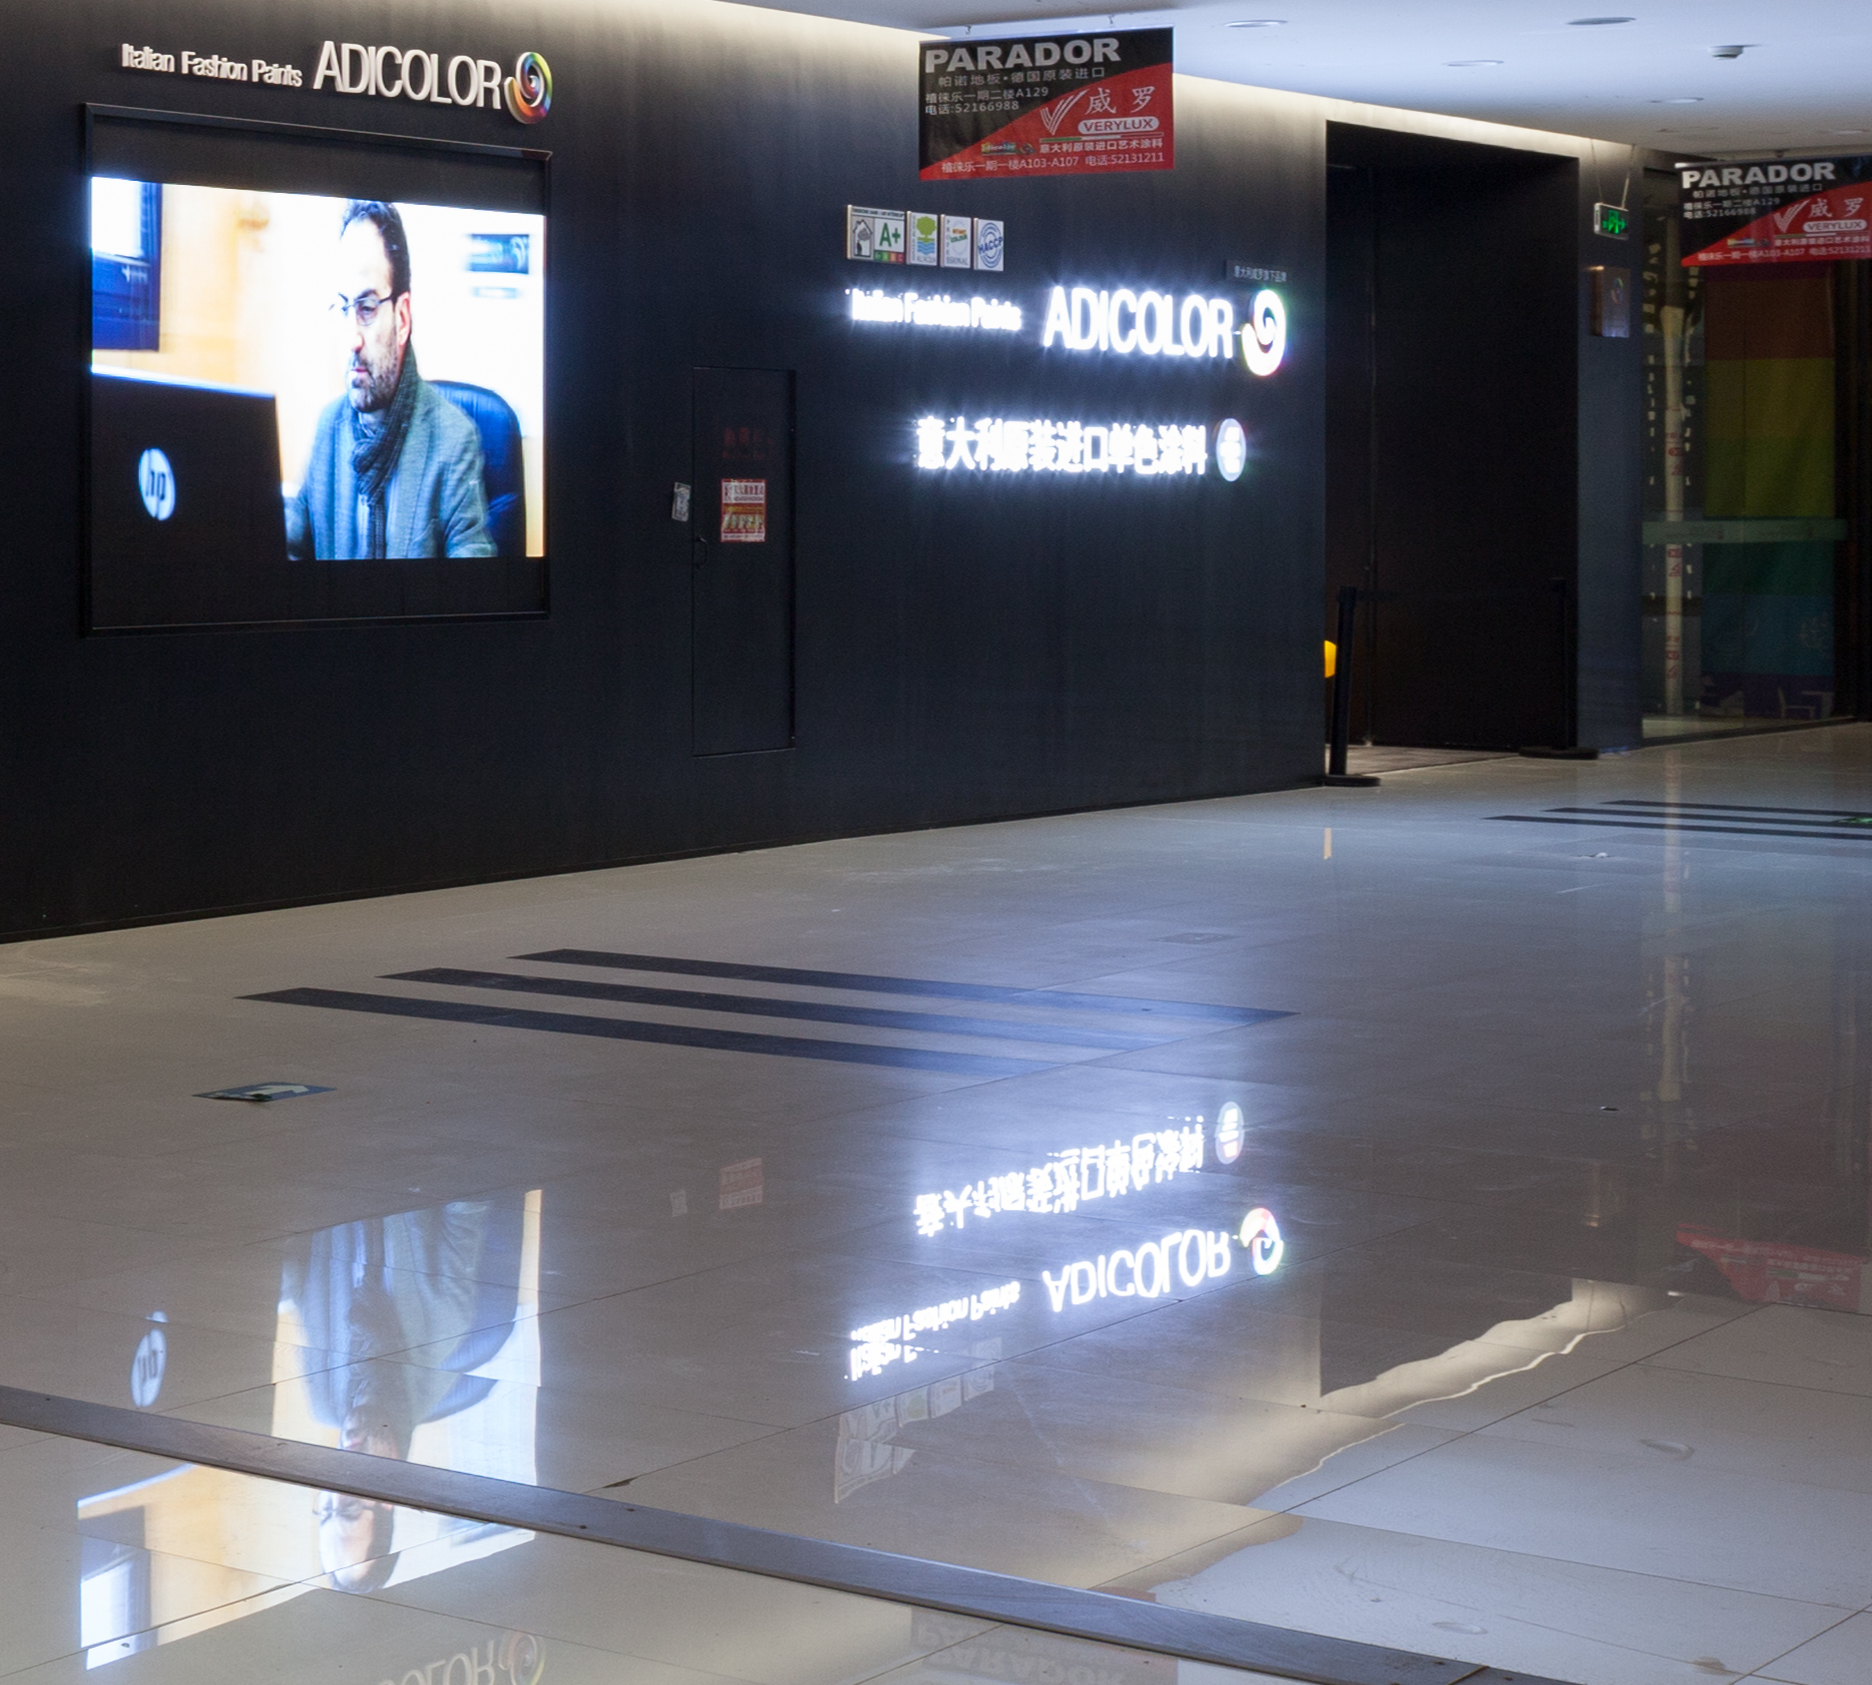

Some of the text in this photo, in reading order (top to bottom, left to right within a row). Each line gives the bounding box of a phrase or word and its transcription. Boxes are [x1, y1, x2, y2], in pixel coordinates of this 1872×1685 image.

[924, 37, 1122, 74] PARADOR
[122, 40, 502, 110] Italian Fashion Paints ADICOLOR
[1084, 86, 1155, 115] 威罗
[1083, 118, 1154, 133] VERYLUX
[1682, 162, 1836, 189] PARADOR
[879, 222, 902, 248] A+
[977, 236, 1004, 255] HACCP
[1042, 284, 1234, 359] ADICOLOR
